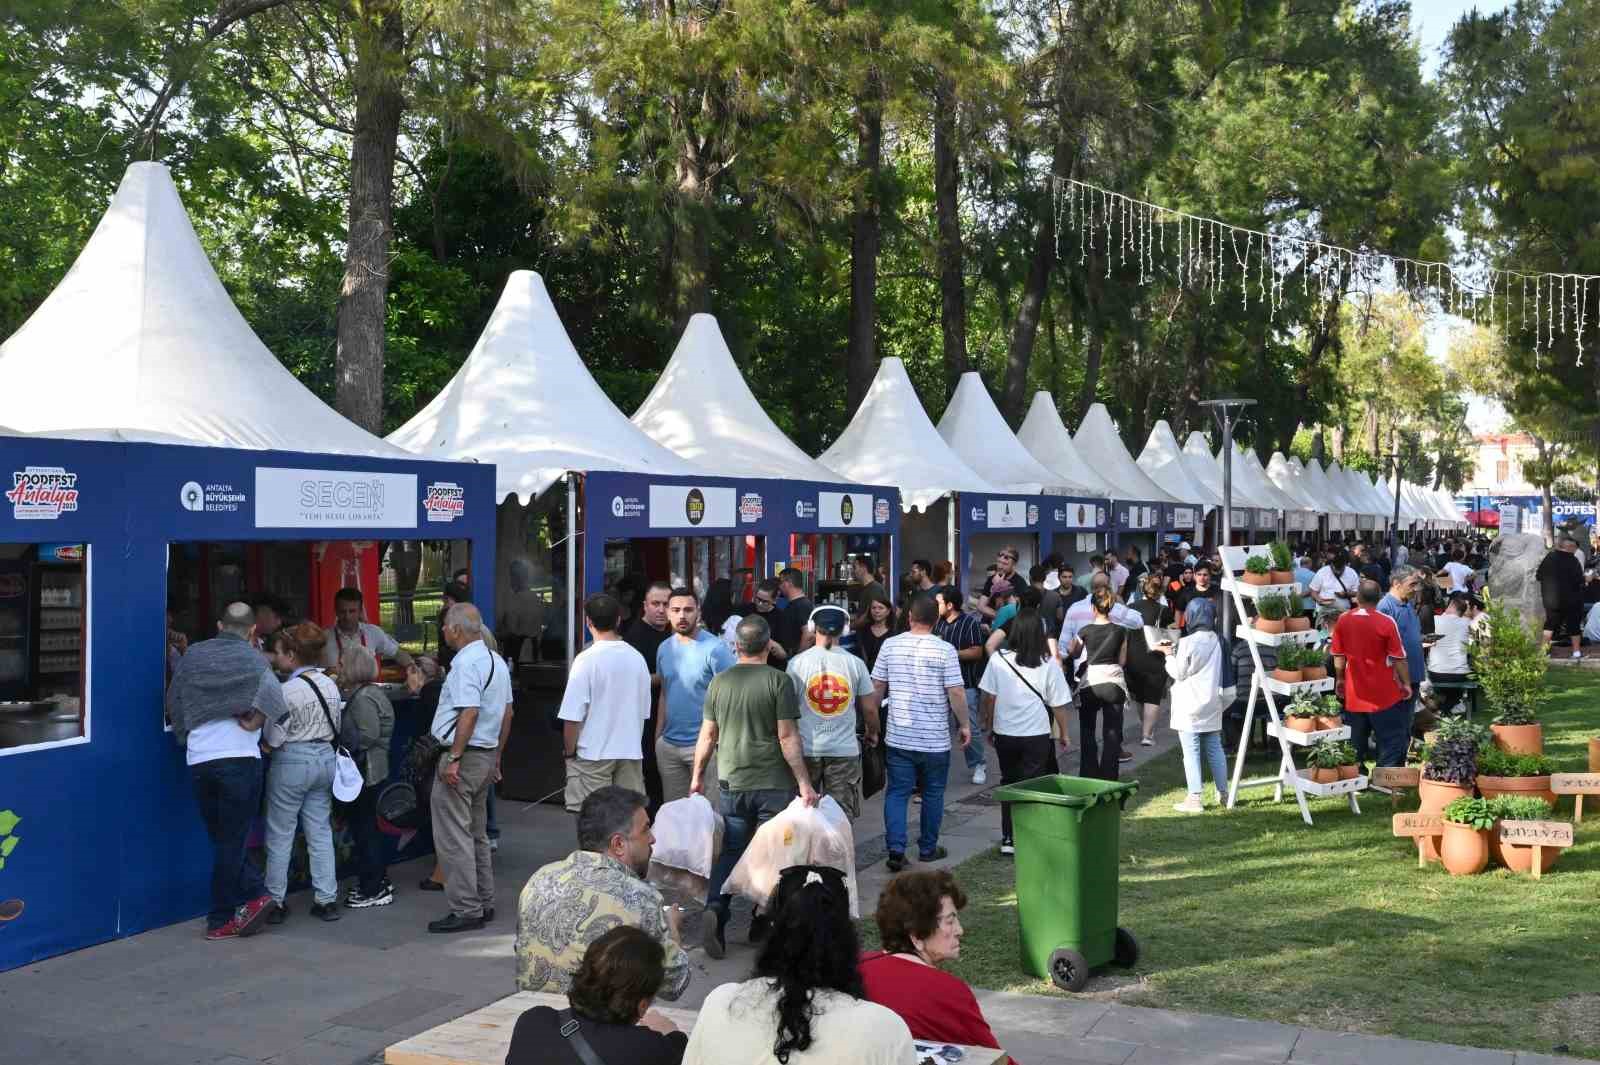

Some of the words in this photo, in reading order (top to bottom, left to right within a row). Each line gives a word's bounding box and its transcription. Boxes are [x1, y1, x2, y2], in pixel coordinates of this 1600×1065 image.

[15, 474, 75, 485] FOODFEST
[205, 484, 232, 492] ANTALYA
[428, 487, 463, 496] FOODFEST
[8, 480, 78, 512] Antalya
